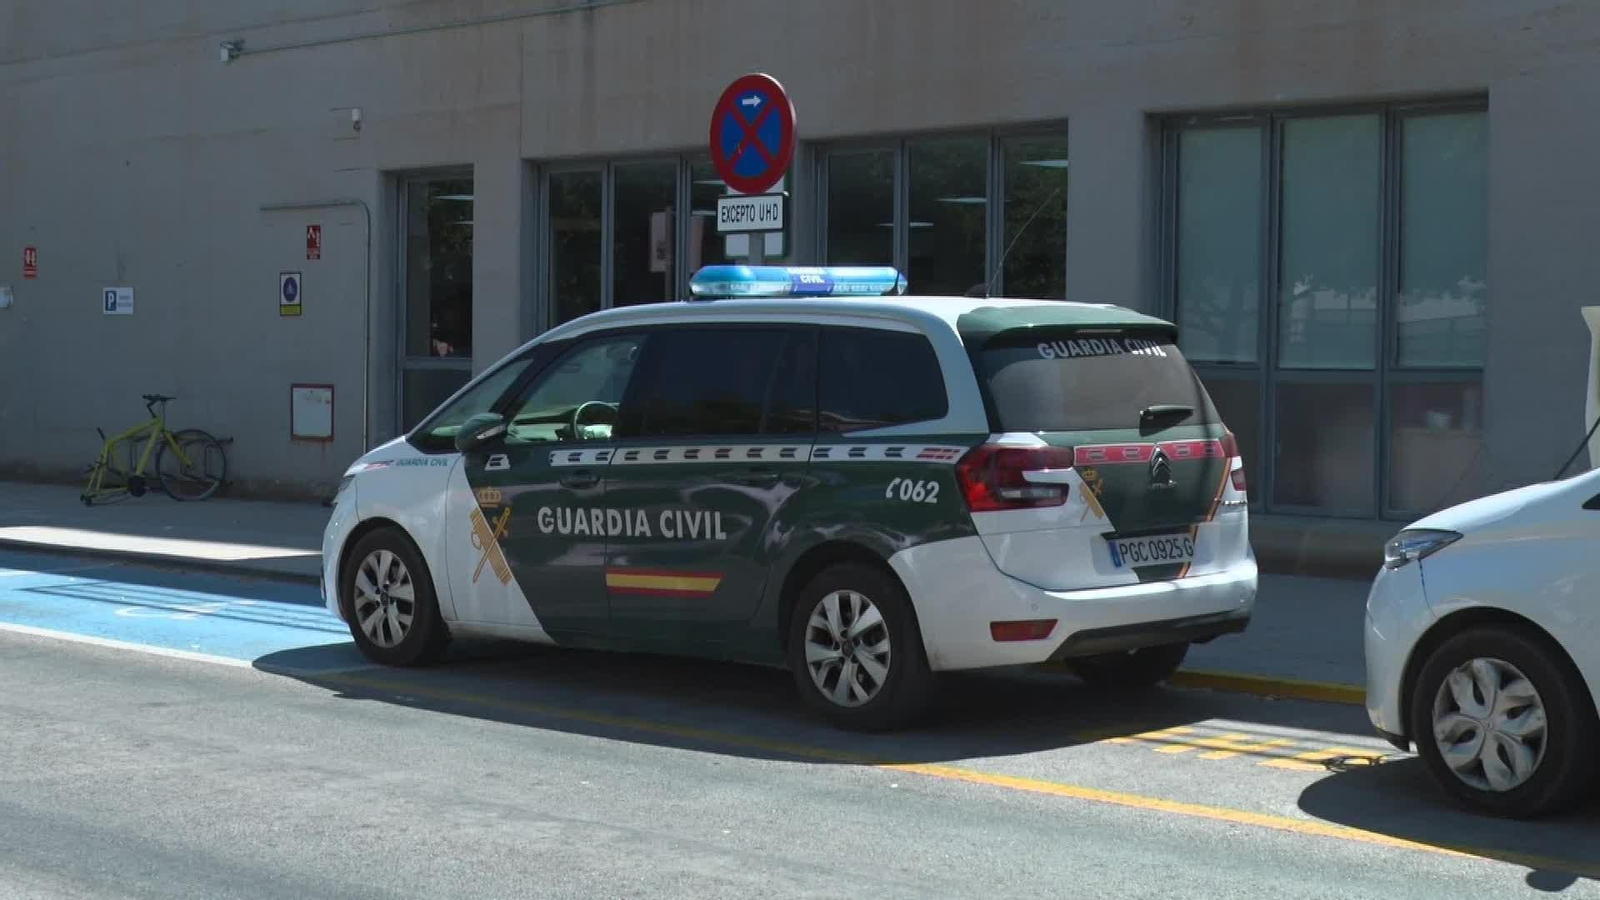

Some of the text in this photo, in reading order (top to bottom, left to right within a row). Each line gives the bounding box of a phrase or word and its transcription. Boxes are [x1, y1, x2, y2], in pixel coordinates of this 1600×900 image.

[721, 203, 778, 223] EXCEPTO UHD
[108, 292, 115, 309] P
[1037, 338, 1167, 360] GUARDIA CIVIL
[900, 479, 940, 503] 062
[537, 506, 727, 540] GUARDIA CIVIL
